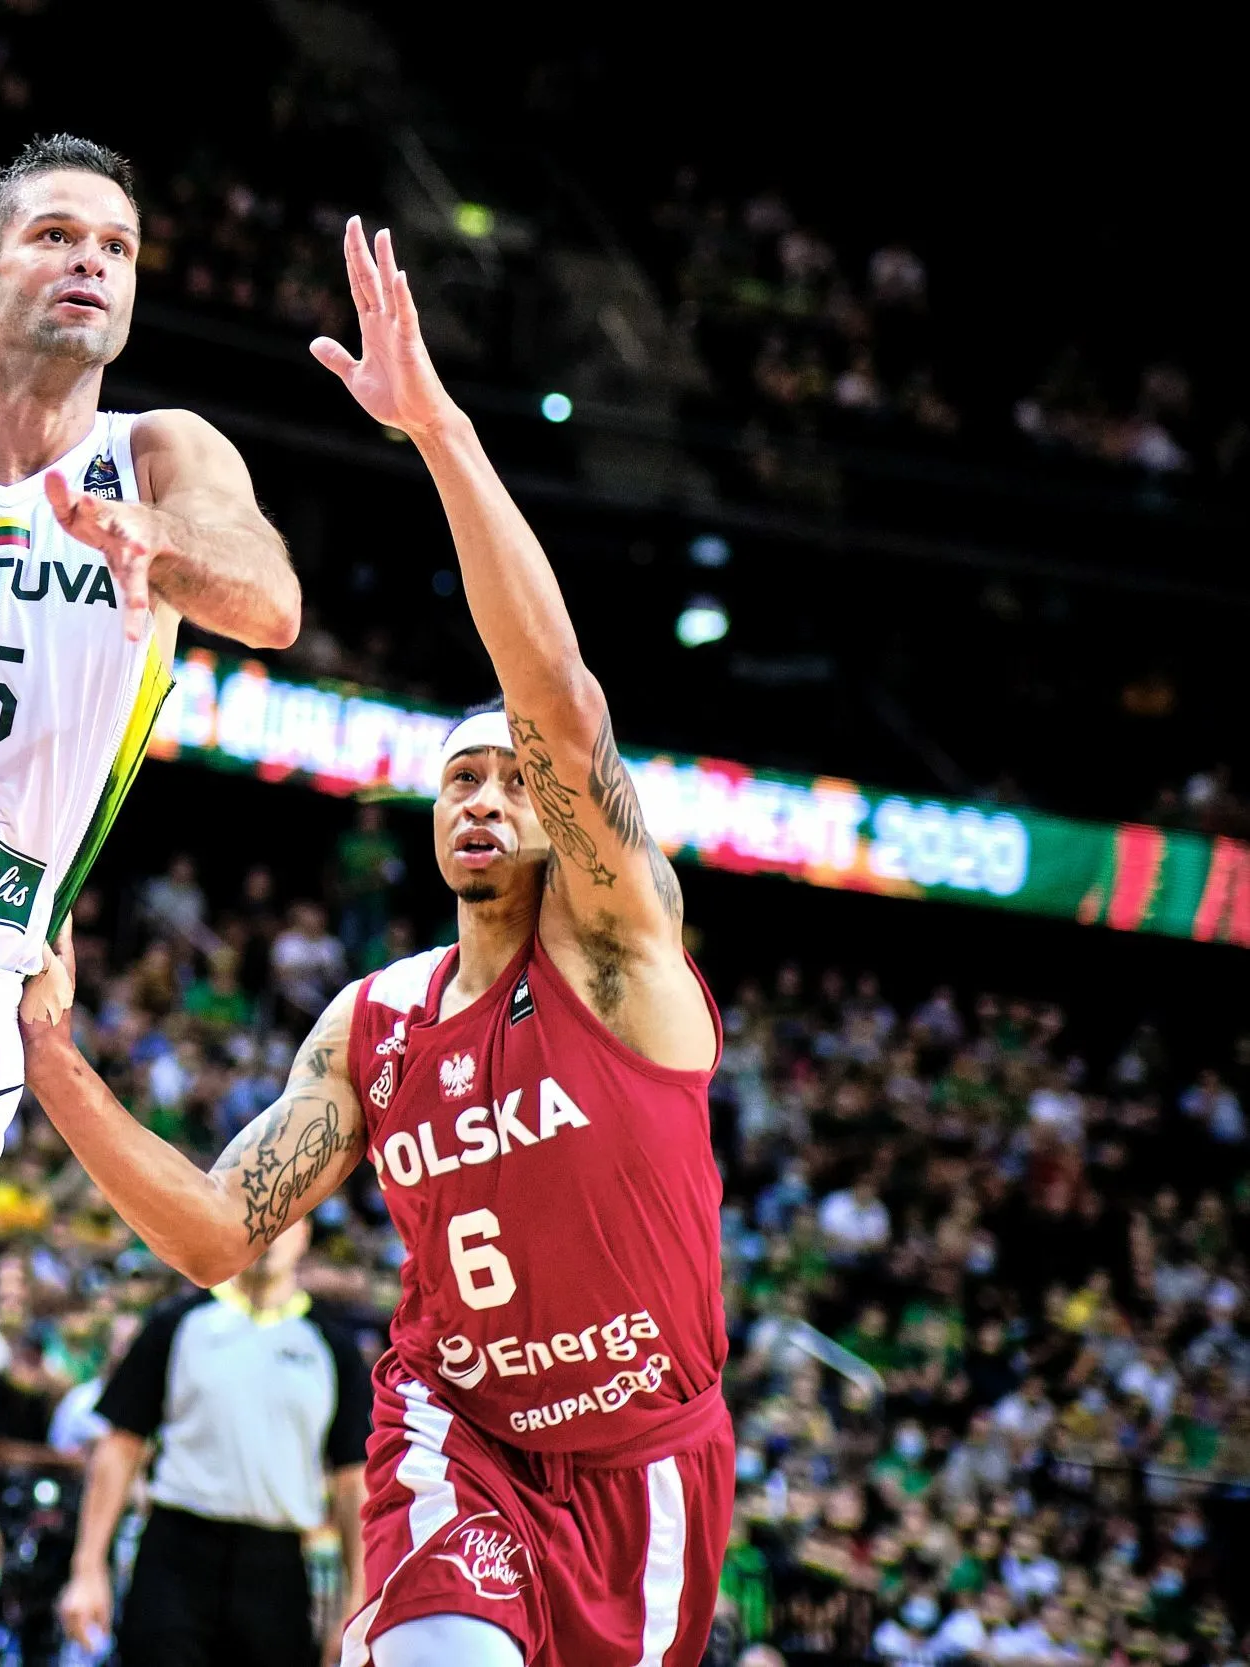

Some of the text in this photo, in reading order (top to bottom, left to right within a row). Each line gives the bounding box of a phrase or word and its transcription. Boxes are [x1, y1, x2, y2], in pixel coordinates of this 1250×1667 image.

[871, 795, 1029, 896] 2020
[447, 1207, 518, 1311] 6
[486, 1310, 660, 1377] Energa
[510, 1393, 598, 1433] GRUPA
[460, 1528, 523, 1563] Polski
